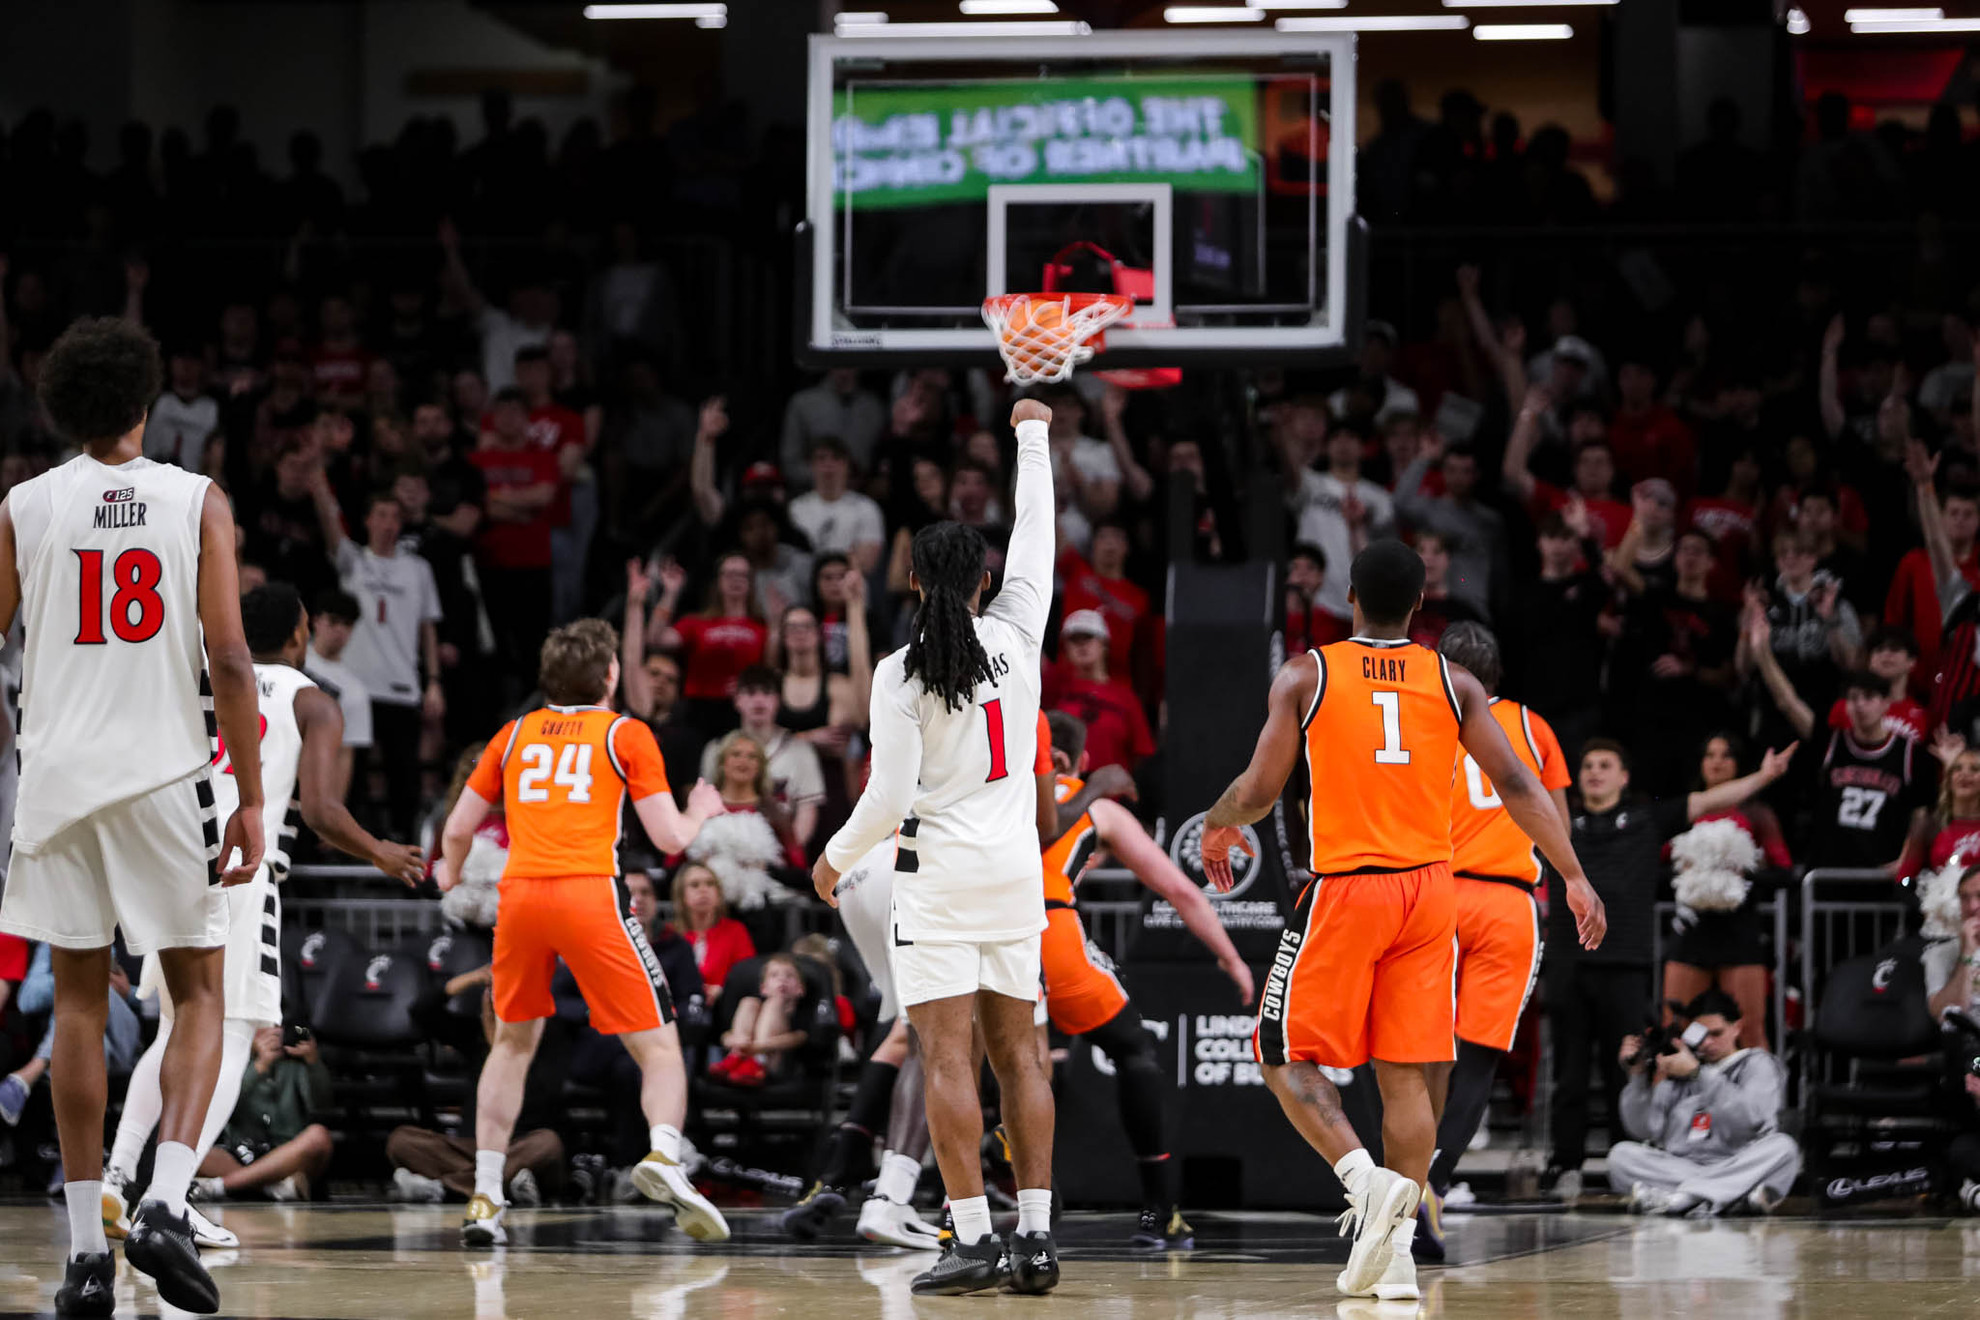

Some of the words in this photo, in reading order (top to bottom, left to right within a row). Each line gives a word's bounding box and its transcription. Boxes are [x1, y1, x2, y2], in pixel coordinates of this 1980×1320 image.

[115, 489, 134, 501] 125
[93, 502, 147, 529] MILLER
[70, 547, 165, 645] 18
[992, 652, 1009, 678] AS
[1362, 656, 1406, 682] CLARY
[978, 697, 1009, 783] 1
[1372, 690, 1411, 766] 1
[518, 743, 593, 804] 24
[1838, 786, 1887, 831] 27
[1263, 928, 1301, 1021] COWBOYS
[1195, 1015, 1258, 1039] LIND
[1195, 1038, 1255, 1062] COLL
[1195, 1062, 1232, 1086] OF
